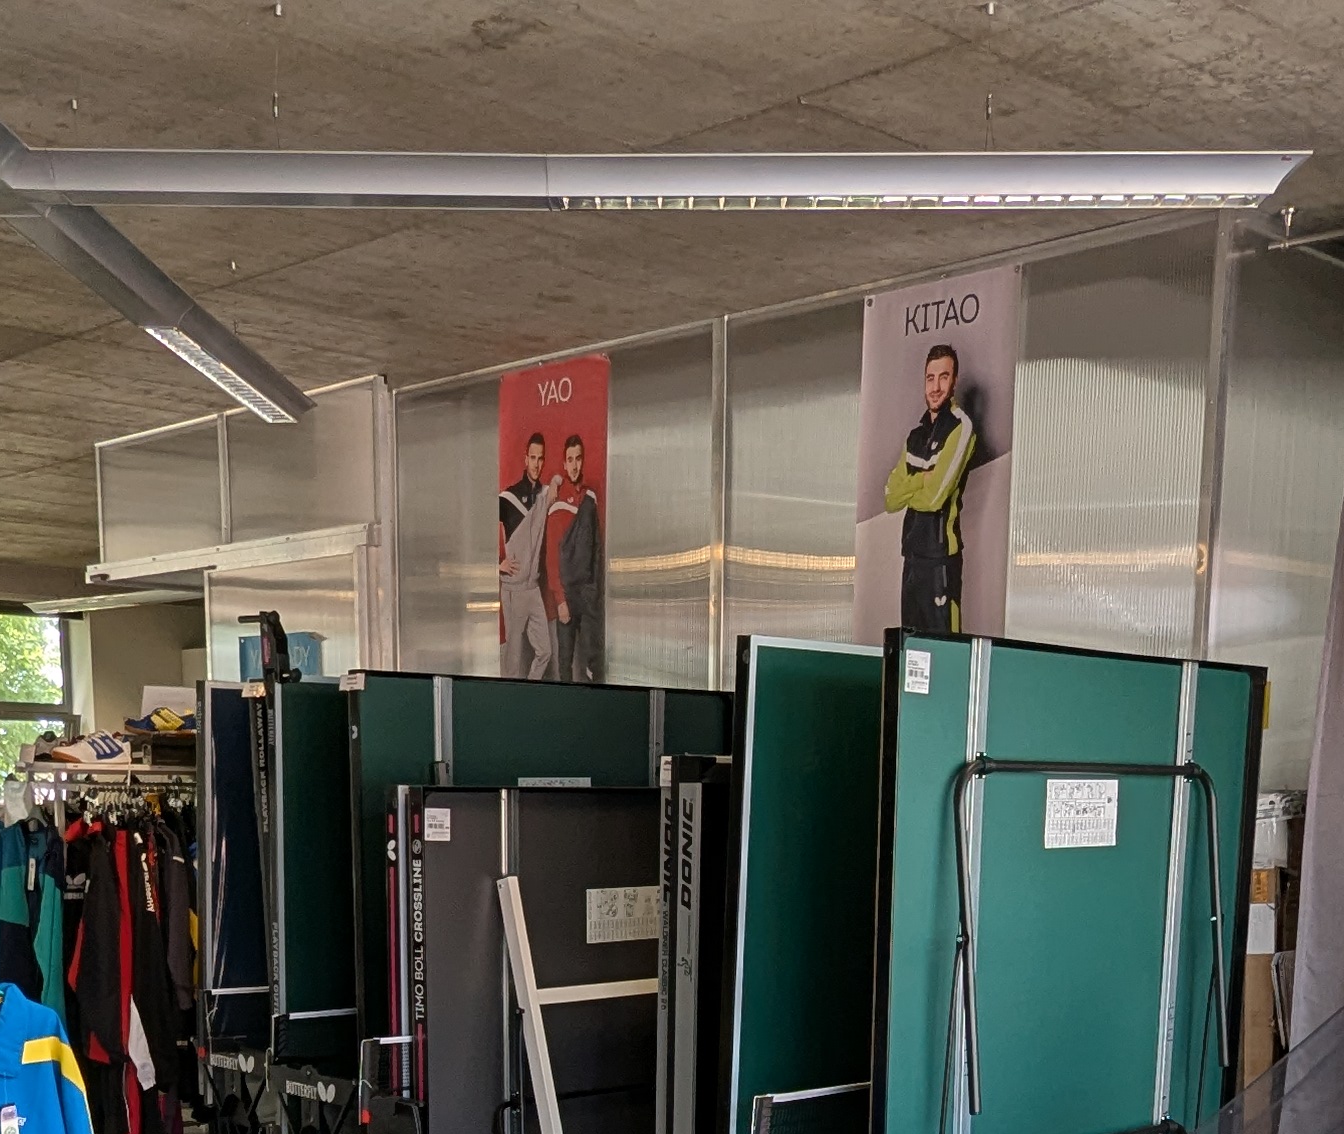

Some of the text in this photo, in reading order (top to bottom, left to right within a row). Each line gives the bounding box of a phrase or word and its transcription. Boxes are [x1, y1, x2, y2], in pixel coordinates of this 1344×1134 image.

[905, 293, 980, 336] KITAO
[537, 377, 572, 407] YAO
[680, 797, 694, 911] DONIC
[271, 922, 279, 981] PLAYBACK
[412, 858, 425, 1021] TIMO BOLL CROSSLINE
